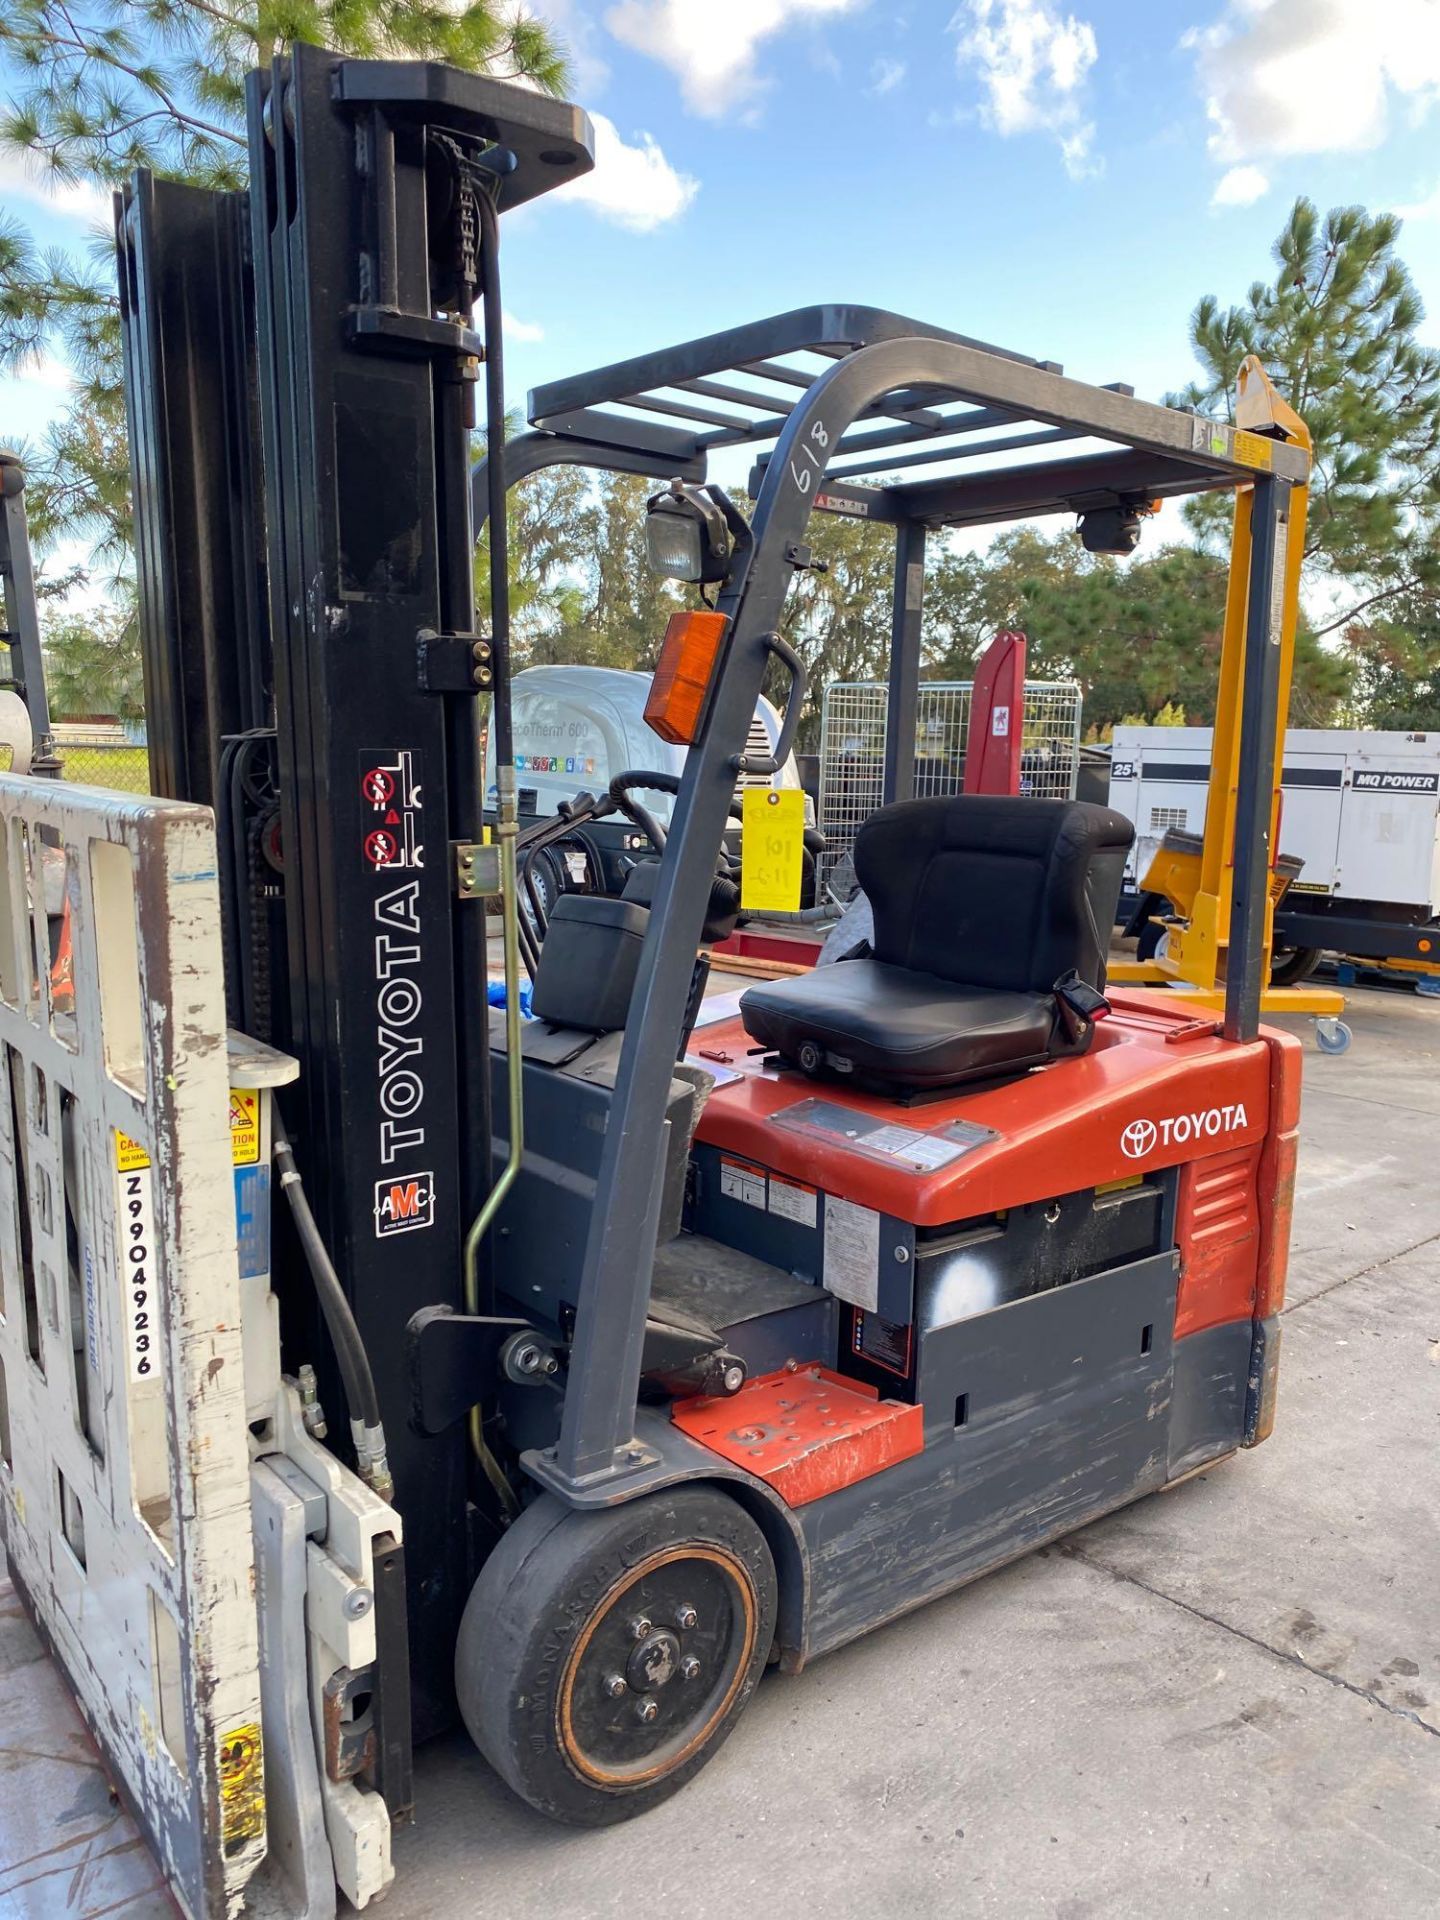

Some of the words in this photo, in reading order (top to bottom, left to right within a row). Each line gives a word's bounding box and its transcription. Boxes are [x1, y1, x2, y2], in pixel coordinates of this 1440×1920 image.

[791, 420, 829, 494] 618
[568, 722, 589, 737] 600
[1113, 763, 1132, 777] 25
[1356, 774, 1381, 787] MQ
[1381, 774, 1435, 788] POWER
[375, 880, 425, 1164] TOYOTA
[1159, 1103, 1248, 1146] TOYOTA
[380, 1181, 428, 1220] AMC
